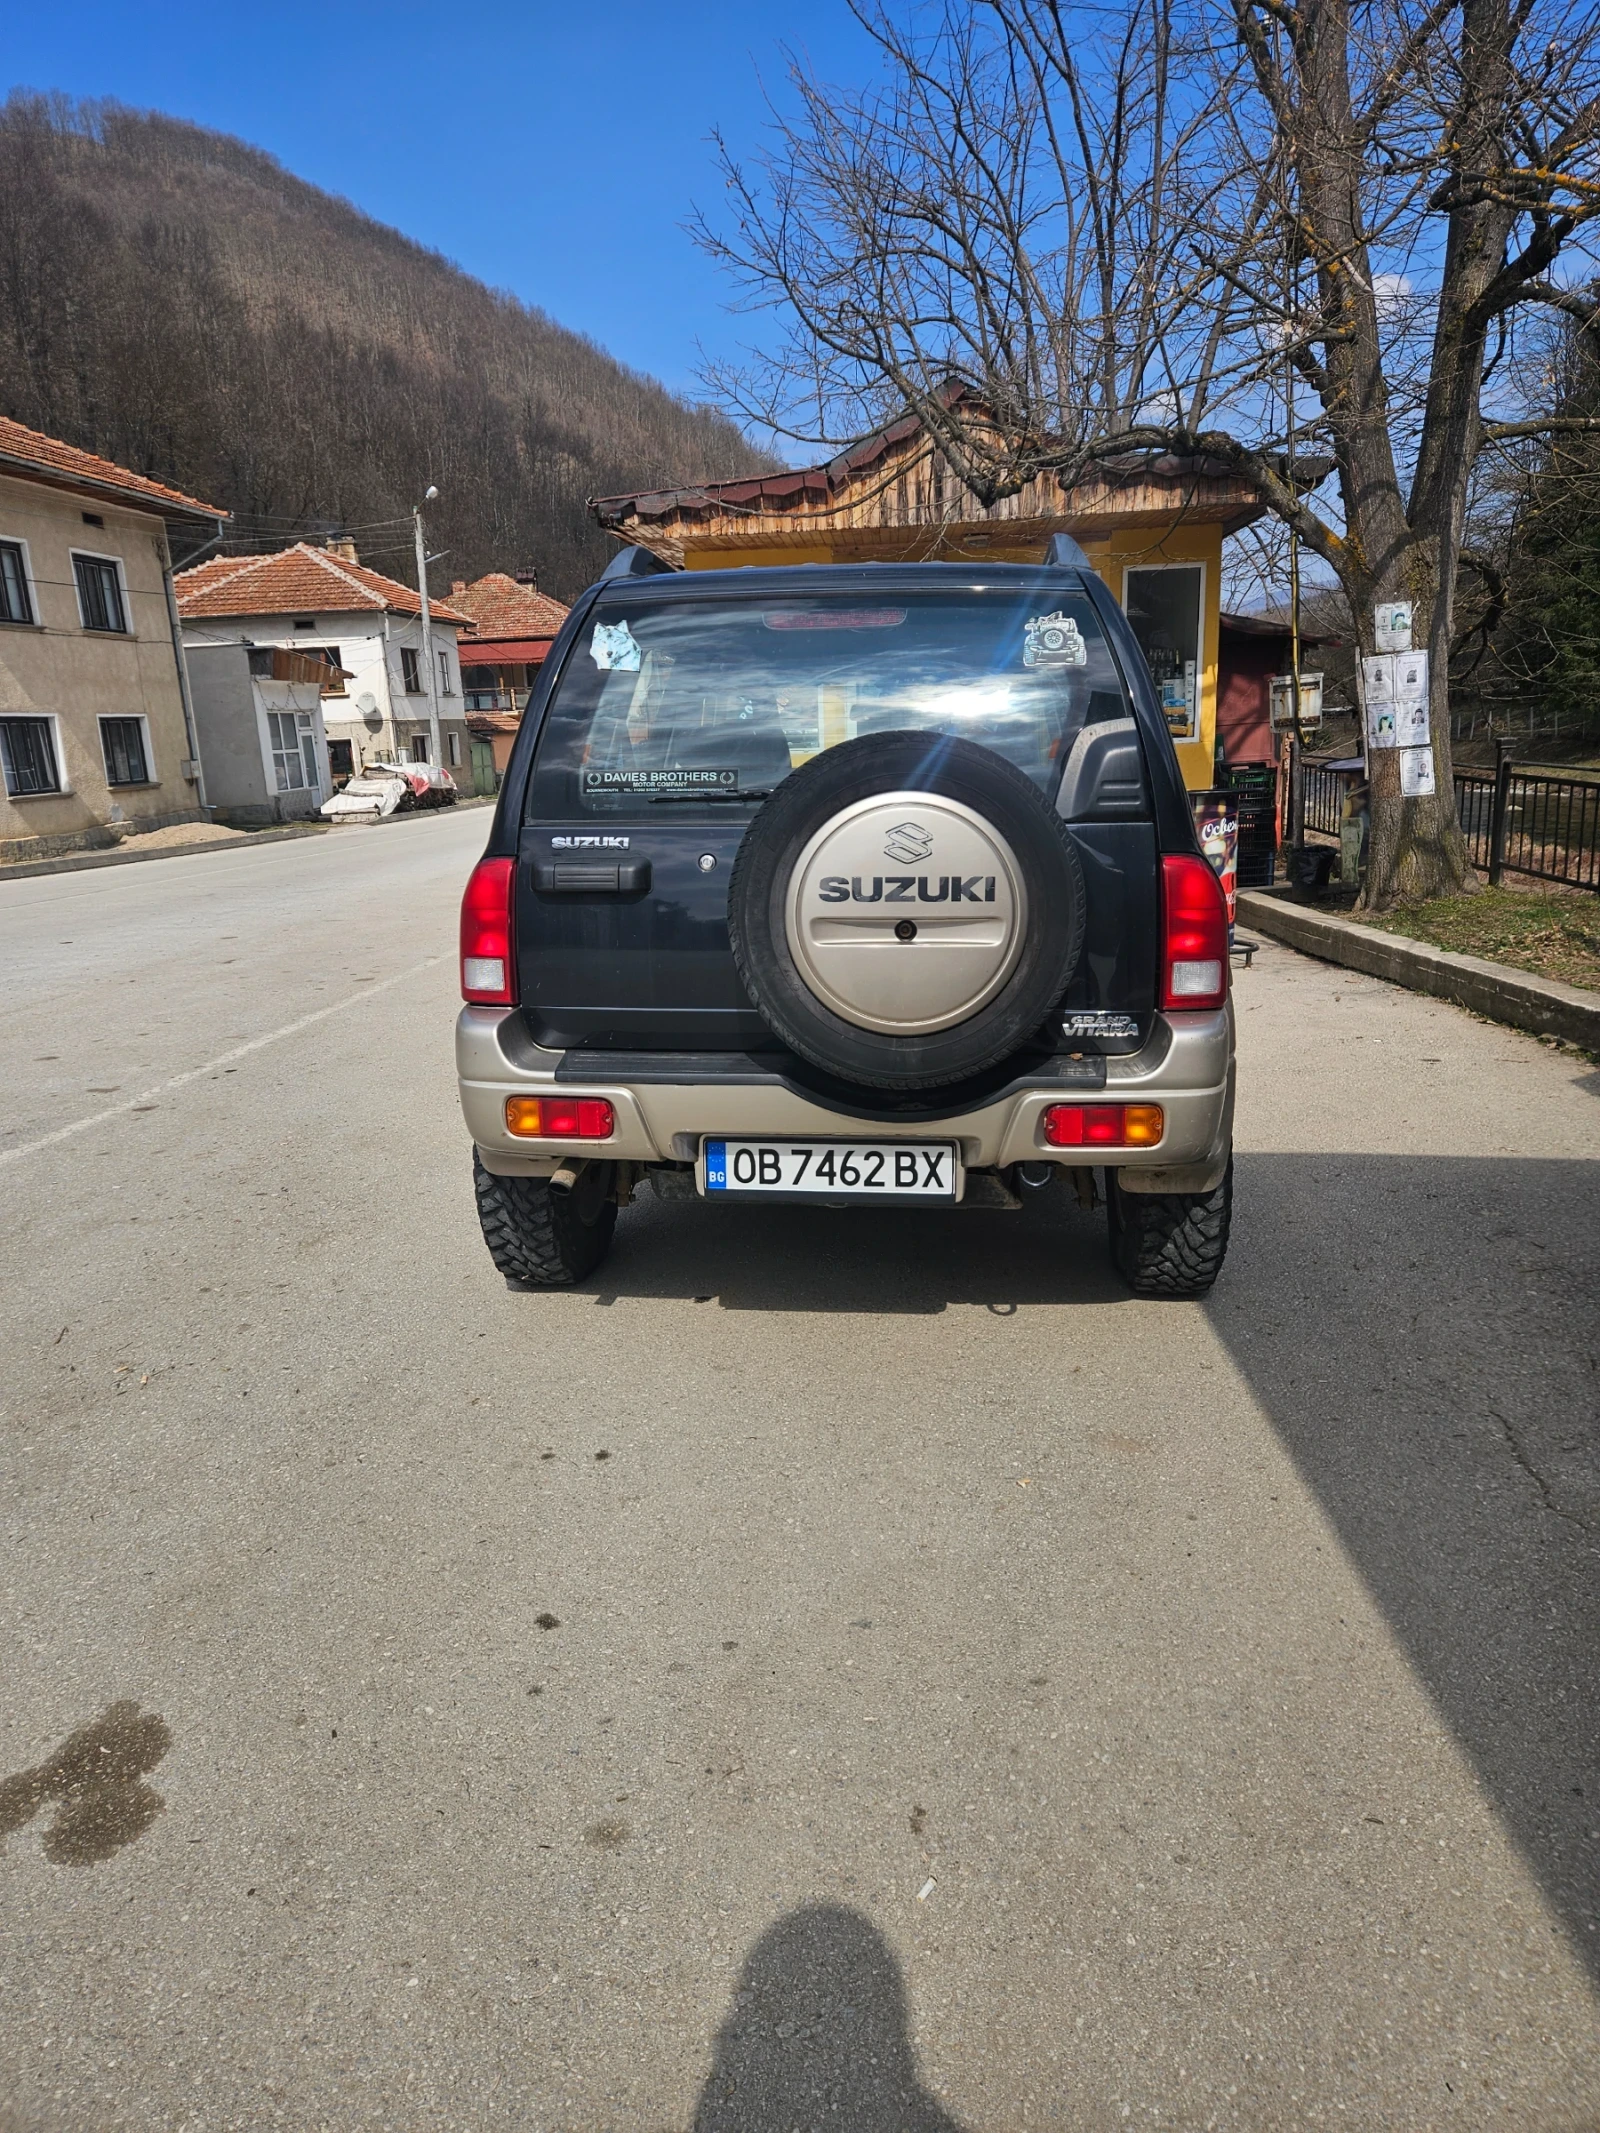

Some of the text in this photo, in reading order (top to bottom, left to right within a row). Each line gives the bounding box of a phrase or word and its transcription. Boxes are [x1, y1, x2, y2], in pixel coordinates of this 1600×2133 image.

[604, 772, 717, 782] DAVIES BROTHERS
[551, 836, 630, 850] SUZUKI
[818, 876, 996, 903] SUZUKI
[1070, 1015, 1132, 1025] GRAND
[1062, 1023, 1139, 1037] VITARA
[733, 1148, 945, 1188] OB 7462 BX
[709, 1171, 725, 1183] BG
